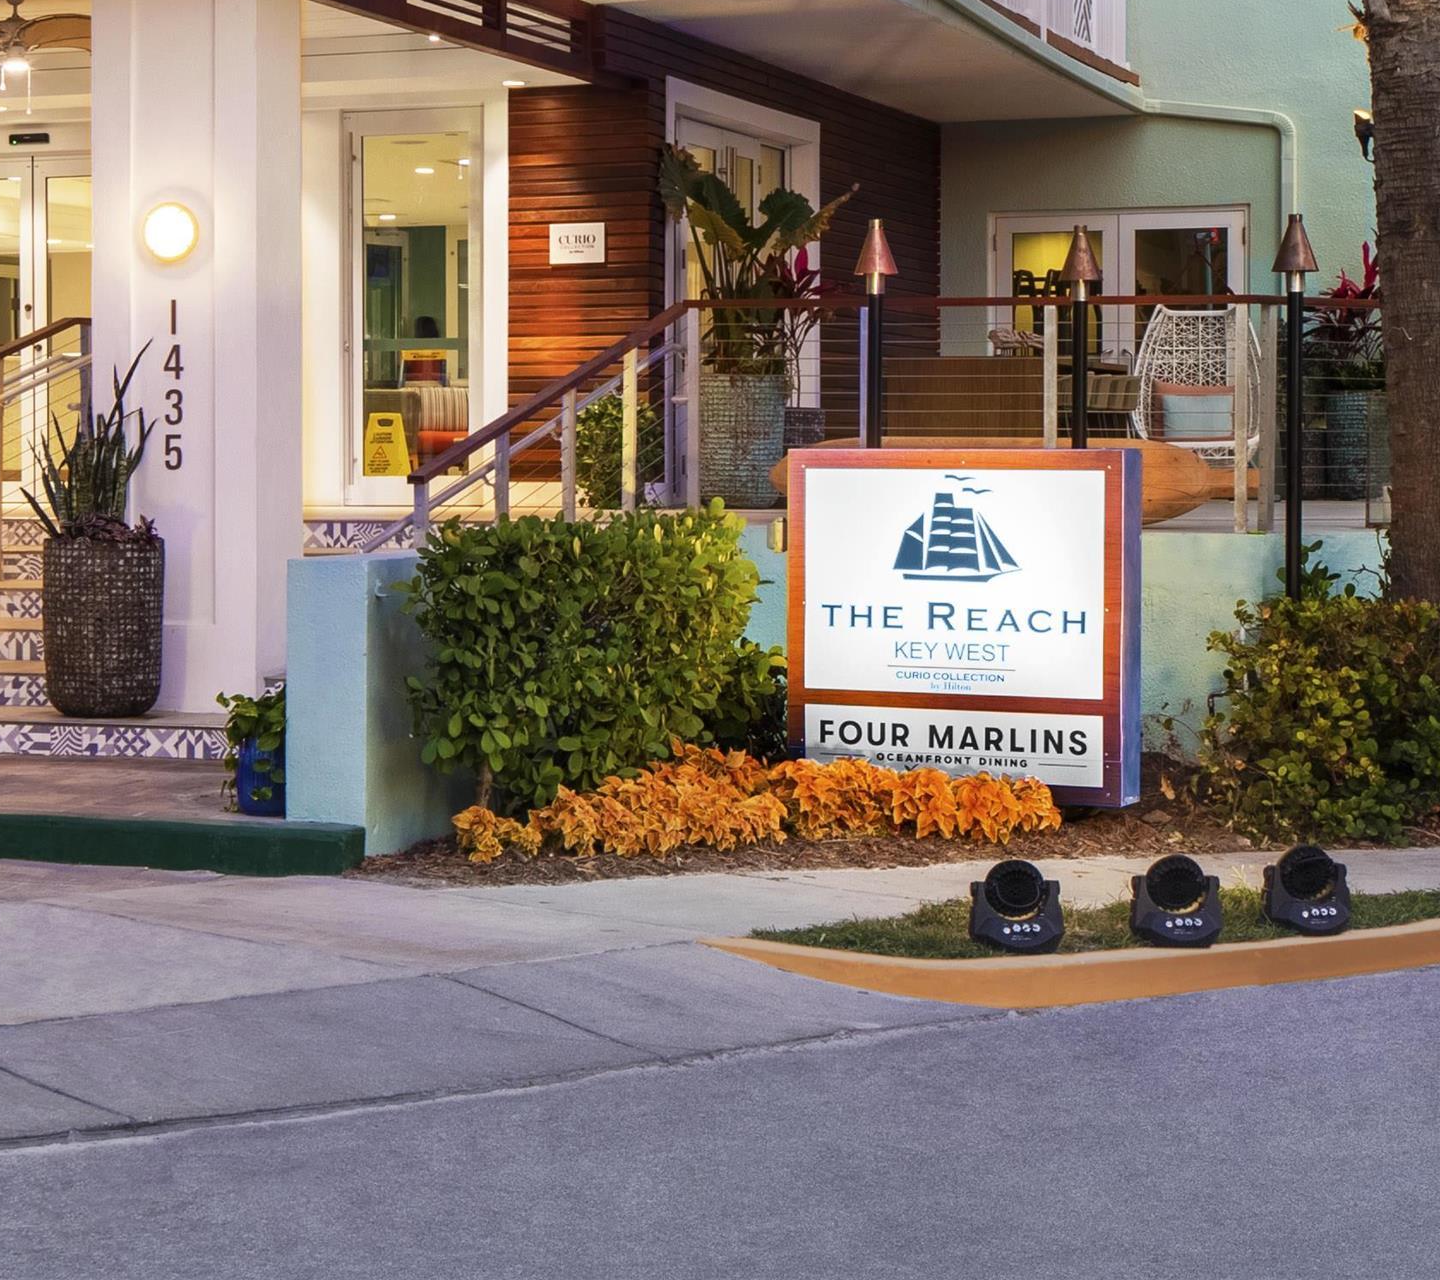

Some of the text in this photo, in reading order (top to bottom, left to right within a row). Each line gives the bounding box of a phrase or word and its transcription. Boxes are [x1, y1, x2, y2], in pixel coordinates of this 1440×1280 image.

[163, 299, 185, 471] 1435
[821, 601, 1087, 634] THE REACH
[894, 640, 1011, 662] KEY WEST
[895, 670, 1005, 682] CURIO COLLECTION
[943, 682, 972, 691] Hilton
[819, 719, 1088, 756] FOUR MARLINS
[876, 752, 1028, 768] OCEANFRONT DINING
